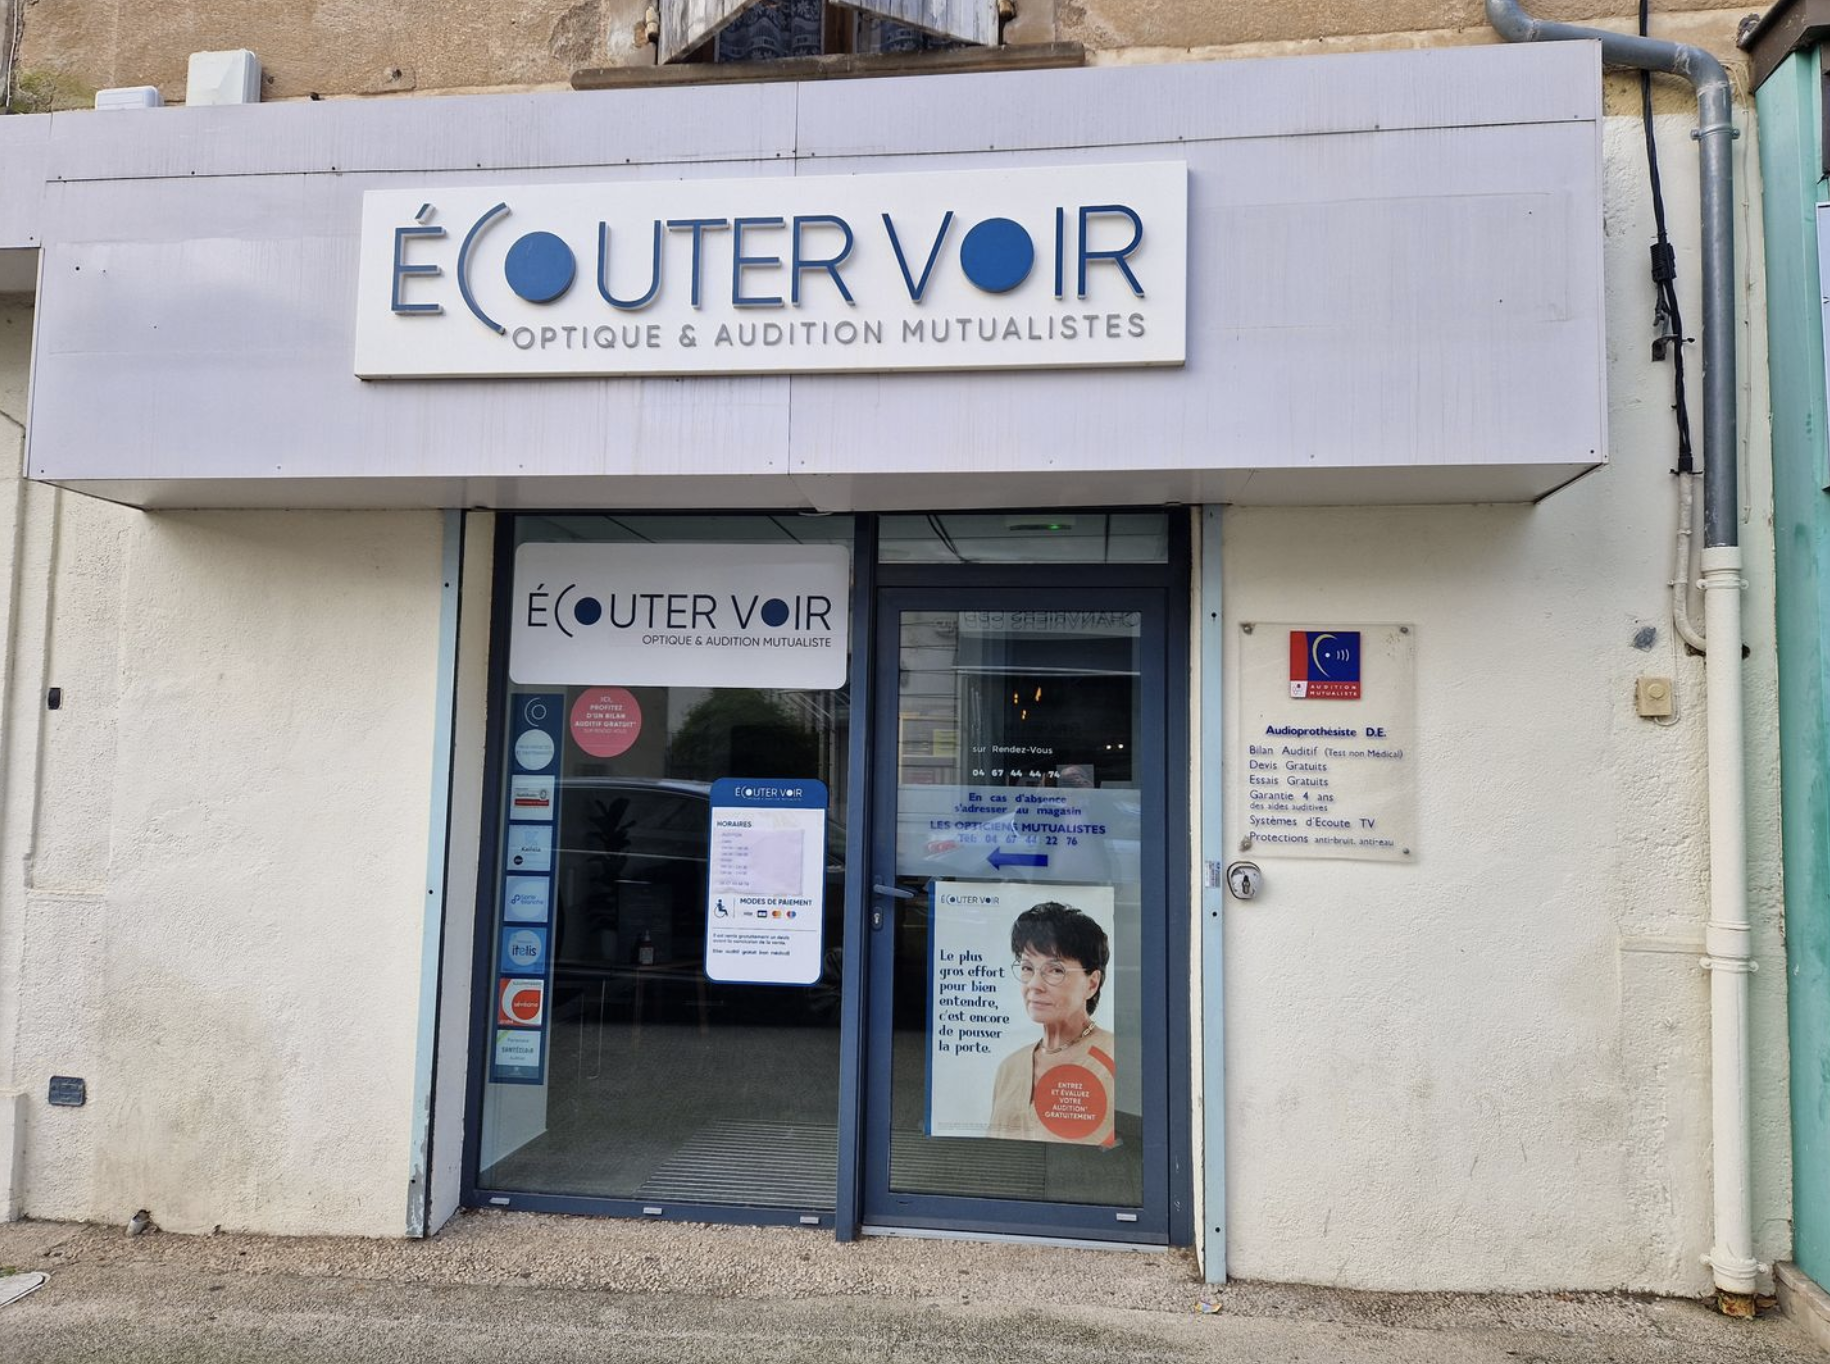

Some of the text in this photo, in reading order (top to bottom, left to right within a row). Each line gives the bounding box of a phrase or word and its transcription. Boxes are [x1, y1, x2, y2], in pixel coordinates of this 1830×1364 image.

[392, 202, 1145, 336] ÉCOUTER VOIR
[512, 313, 1146, 349] OPTIQUE & AUDITION MUTUALISTES
[527, 583, 832, 638] ÉCOUTER VOIR
[642, 634, 832, 648] OPTIQUE & AUDITION MUTUALISTE
[1266, 725, 1387, 738] Audioprothésiste D.E.
[992, 745, 1053, 754] Rendez-Vous
[1249, 745, 1273, 755] Bilan
[1282, 745, 1318, 756] Auditif
[1324, 747, 1346, 758] (Test
[1349, 750, 1365, 758] non
[1249, 759, 1327, 771] Devis Gratuits
[991, 769, 1004, 777] 67
[1010, 769, 1022, 777] 44
[1249, 774, 1329, 786] Essais Gratuits
[780, 789, 803, 798] VOIR
[968, 792, 1067, 804] En cas d'absence
[1250, 789, 1334, 802] Garantie 4 ans
[954, 803, 1081, 818] s'adresser au magasin
[1250, 802, 1328, 812] des aides auditives
[716, 820, 752, 828] HORAIRES
[930, 820, 1106, 835] LES OPTICIENS MUTUALISTES
[1250, 815, 1375, 828] Systèmes d'Ecoute TV
[985, 835, 997, 844] 04
[1006, 835, 1016, 844] 67
[1045, 836, 1058, 845] 22
[1066, 836, 1078, 845] 76
[1250, 831, 1308, 843] Protections
[1359, 837, 1394, 846] anti-eau
[512, 944, 537, 956] itelis
[940, 949, 983, 965] Le plus
[940, 965, 1005, 980] gros effort
[940, 980, 996, 995] pour bien
[939, 995, 999, 1010] entendre,
[939, 1009, 1010, 1025] c'est encore
[939, 1024, 1002, 1041] de pousser
[939, 1039, 991, 1056] la porte.
[1060, 1089, 1090, 1098] ÉVALUEZ
[1045, 1111, 1096, 1120] GRATUITEMENT
